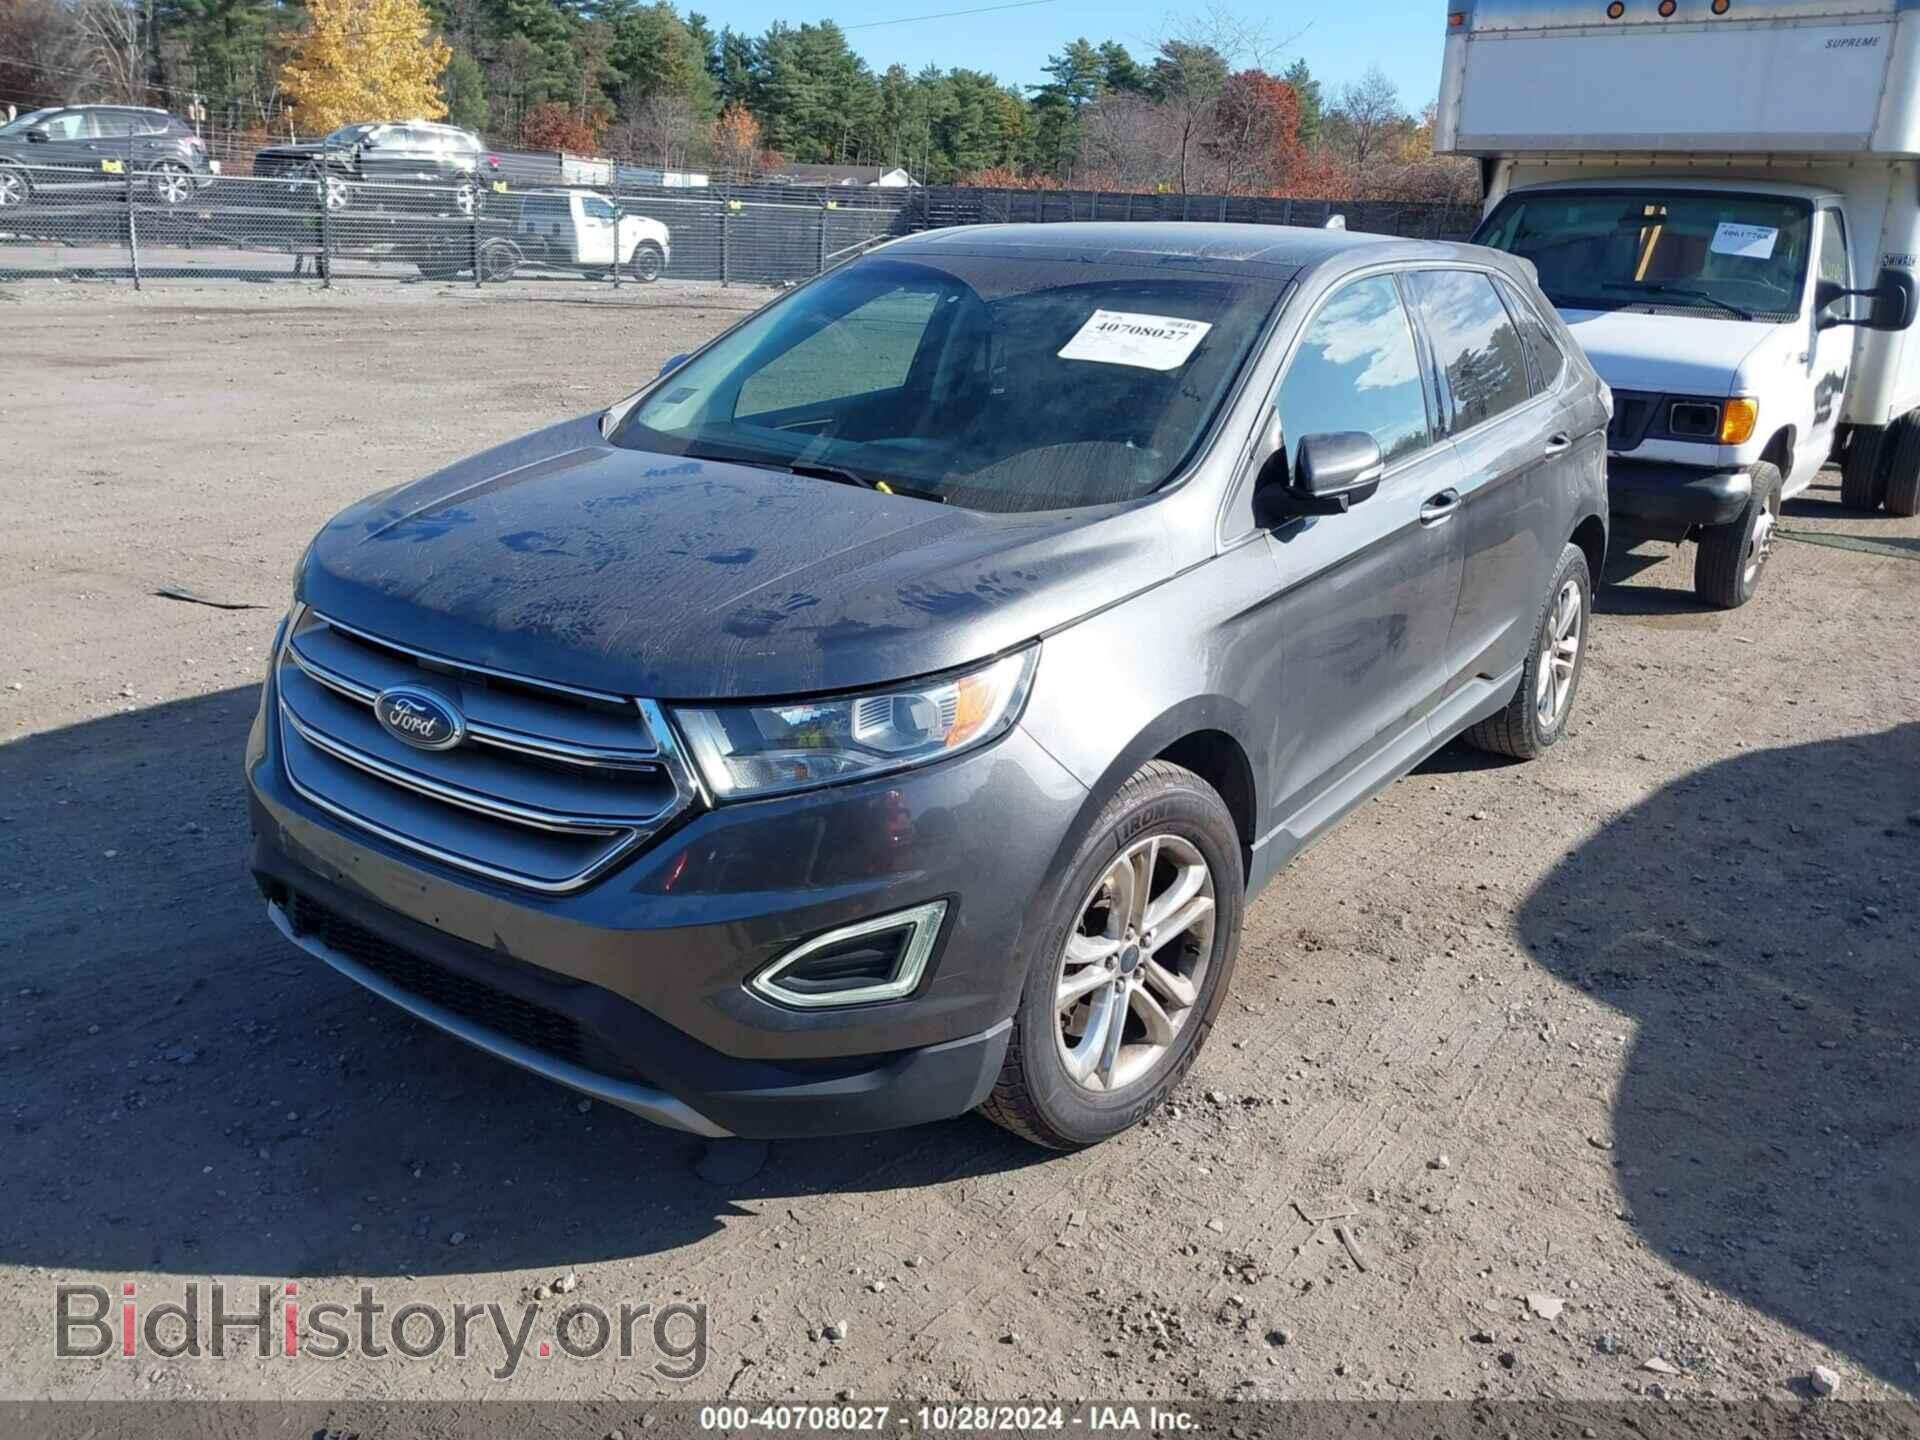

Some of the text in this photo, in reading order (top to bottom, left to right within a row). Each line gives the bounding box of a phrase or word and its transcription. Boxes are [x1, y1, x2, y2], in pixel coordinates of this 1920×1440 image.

[1824, 36, 1881, 49] SUPREME
[1095, 321, 1190, 341] 40708027
[389, 698, 435, 737] Ford
